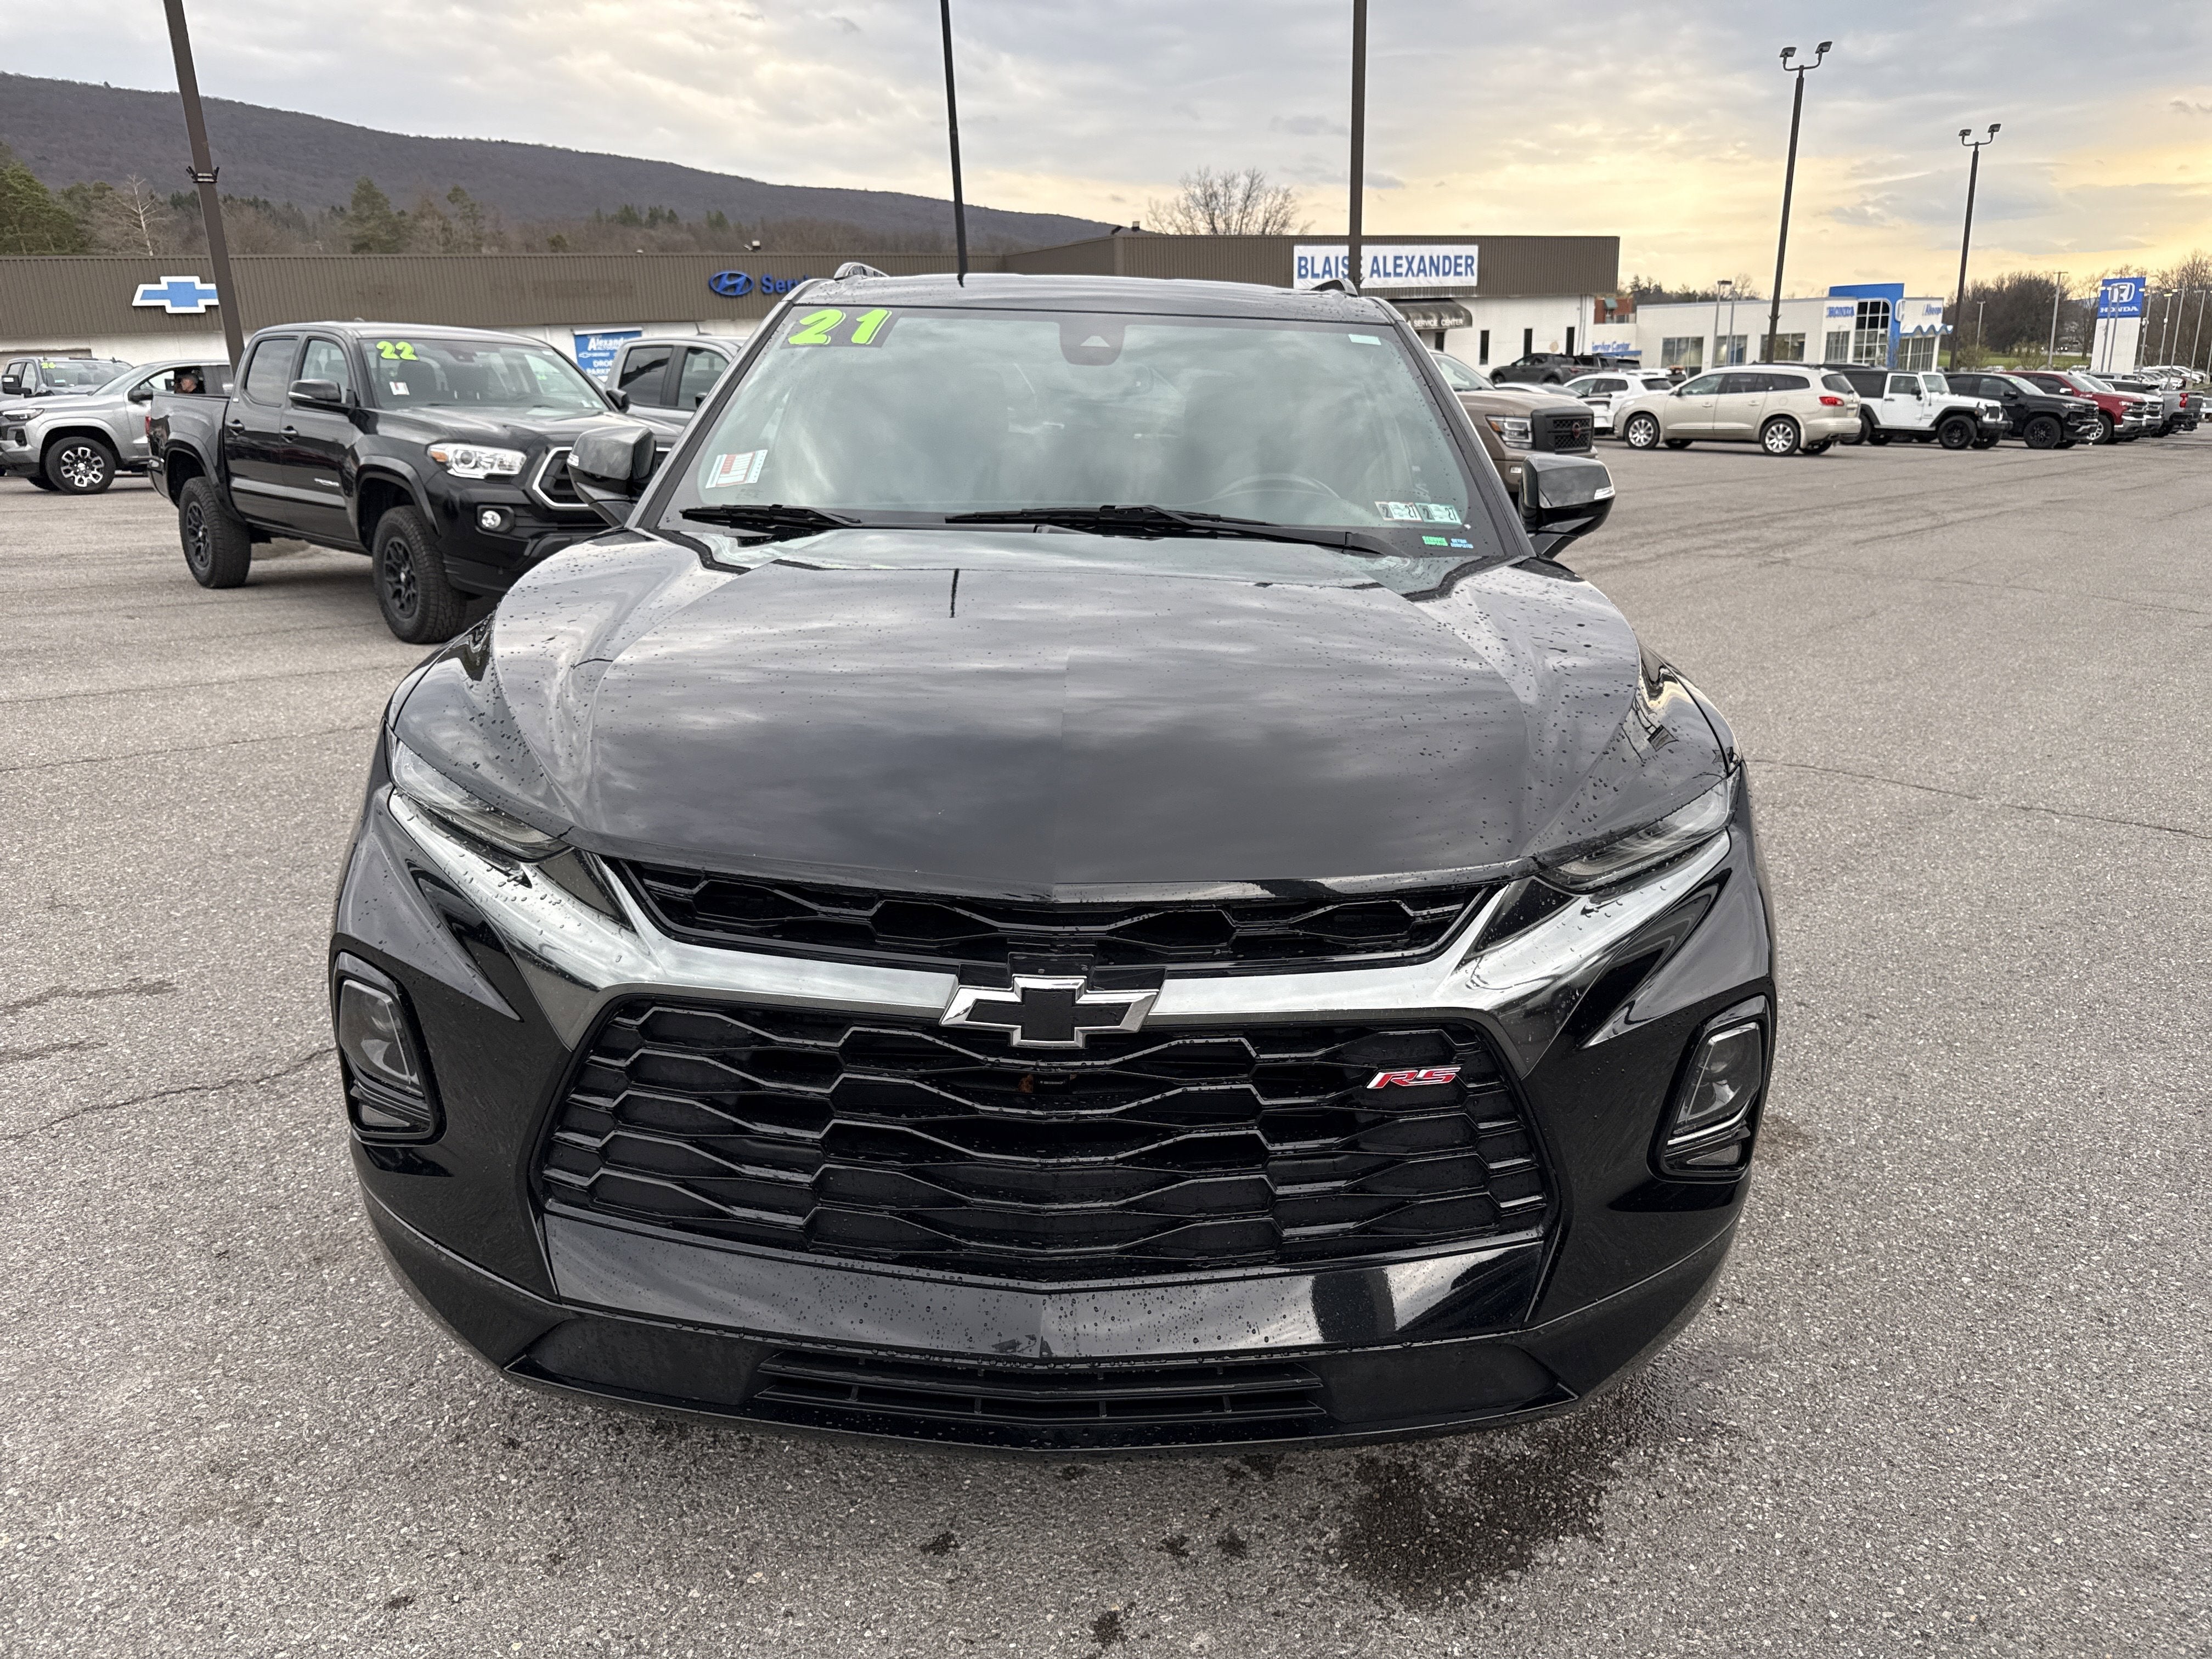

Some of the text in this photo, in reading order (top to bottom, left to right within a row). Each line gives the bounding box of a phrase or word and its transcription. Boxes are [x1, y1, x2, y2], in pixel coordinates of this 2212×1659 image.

[1297, 255, 1475, 279] BLAIS ALEXANDER
[788, 309, 892, 345] 21
[1413, 319, 1438, 327] SERVICE
[1441, 318, 1464, 326] CENTER
[376, 341, 419, 360] 22
[1366, 1067, 1462, 1089] RS
